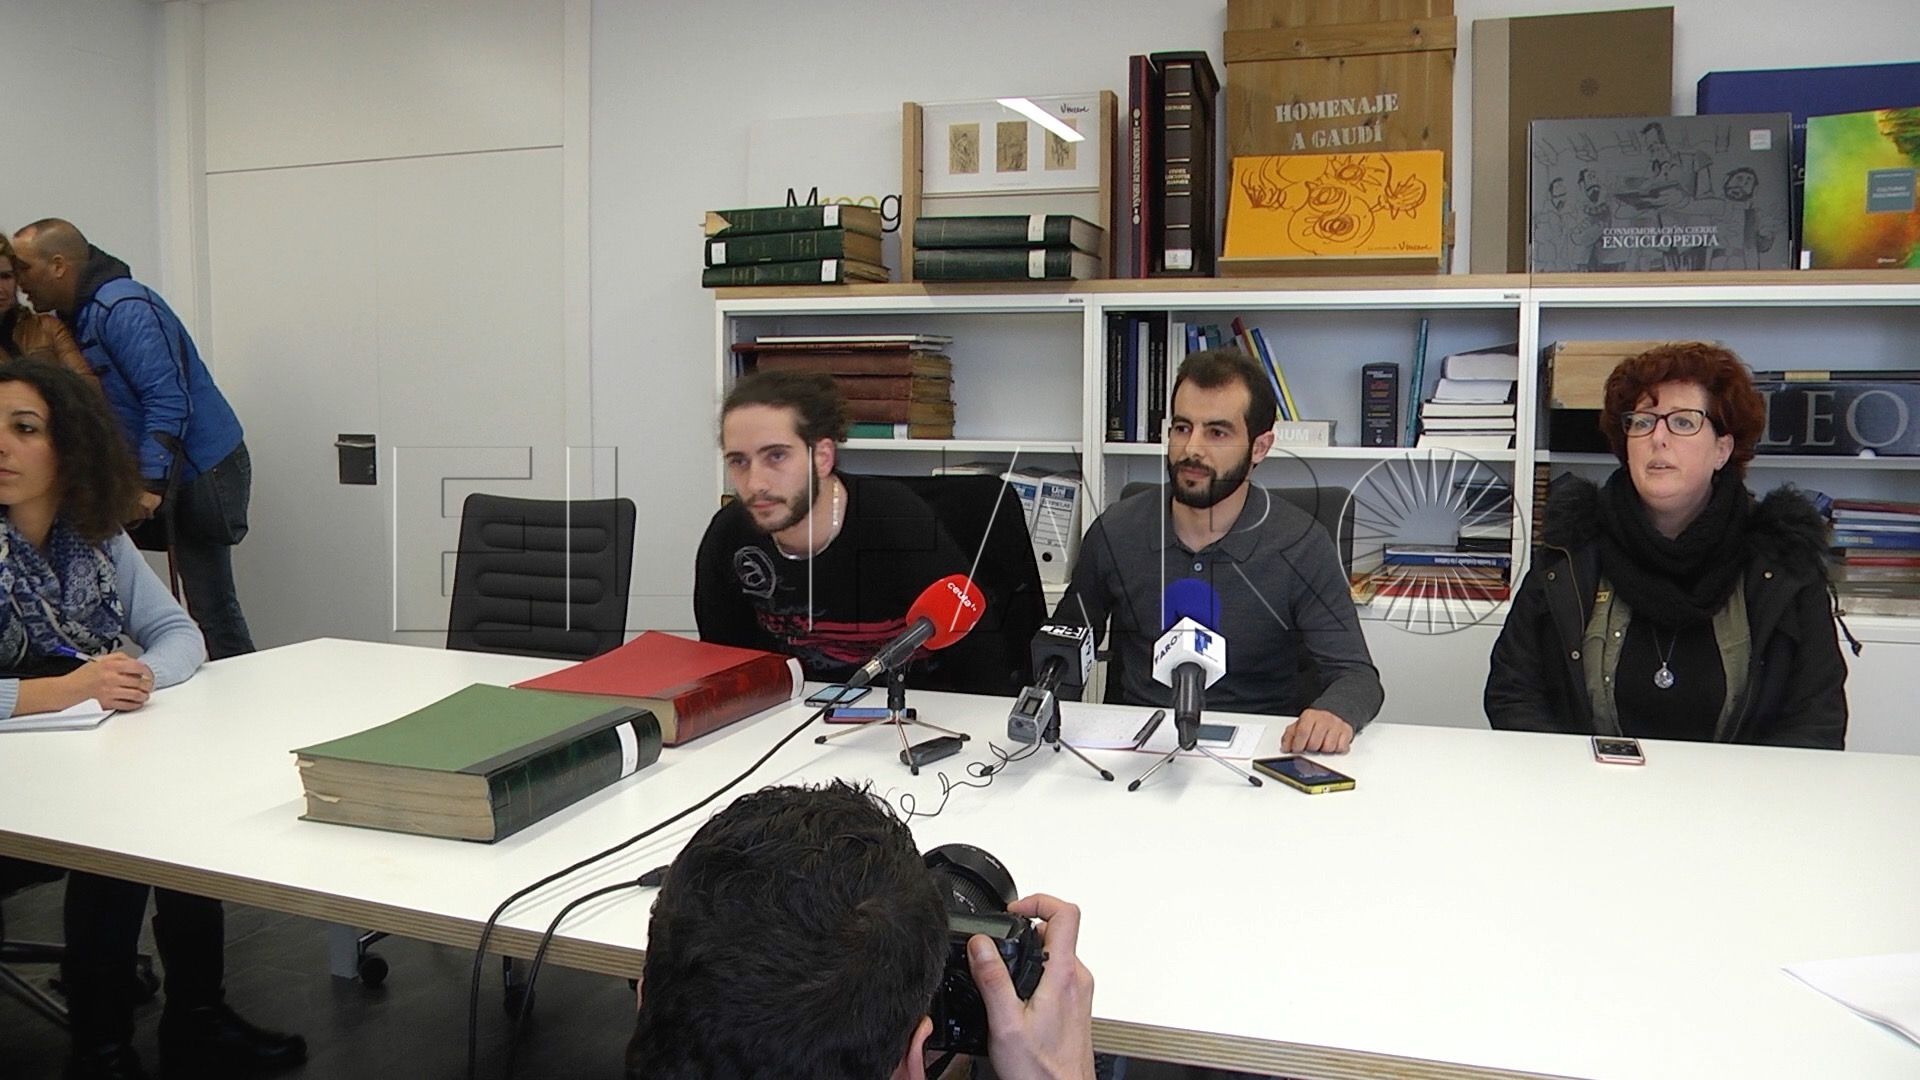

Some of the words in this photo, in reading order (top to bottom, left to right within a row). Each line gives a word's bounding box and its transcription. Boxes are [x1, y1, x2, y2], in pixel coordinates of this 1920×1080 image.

[1275, 93, 1399, 123] HOMENAJE
[1292, 132, 1306, 151] A
[1312, 119, 1383, 149] GAUDÍ
[1602, 234, 1719, 249] ENCICLOPEDIA
[1603, 225, 1683, 236] CONMEMORACIÓN
[1154, 635, 1178, 665] FARO
